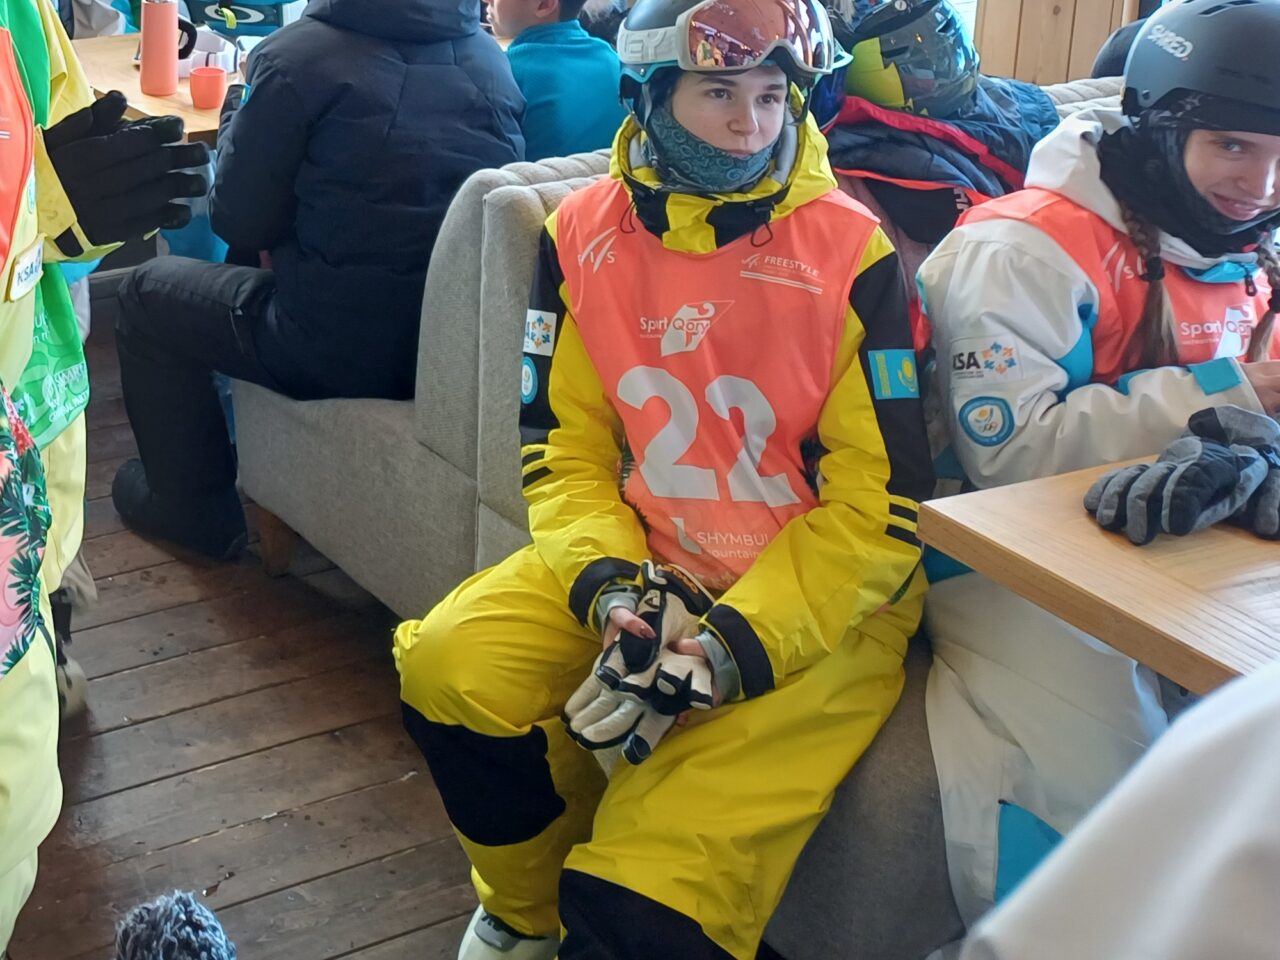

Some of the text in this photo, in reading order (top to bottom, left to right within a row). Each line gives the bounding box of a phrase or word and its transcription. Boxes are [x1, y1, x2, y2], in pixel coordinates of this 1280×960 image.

[764, 254, 820, 278] FREESTYLE
[640, 316, 669, 333] Sprt
[617, 365, 801, 508] 22
[697, 531, 770, 547] SHYMBUL
[711, 548, 760, 560] ountain
